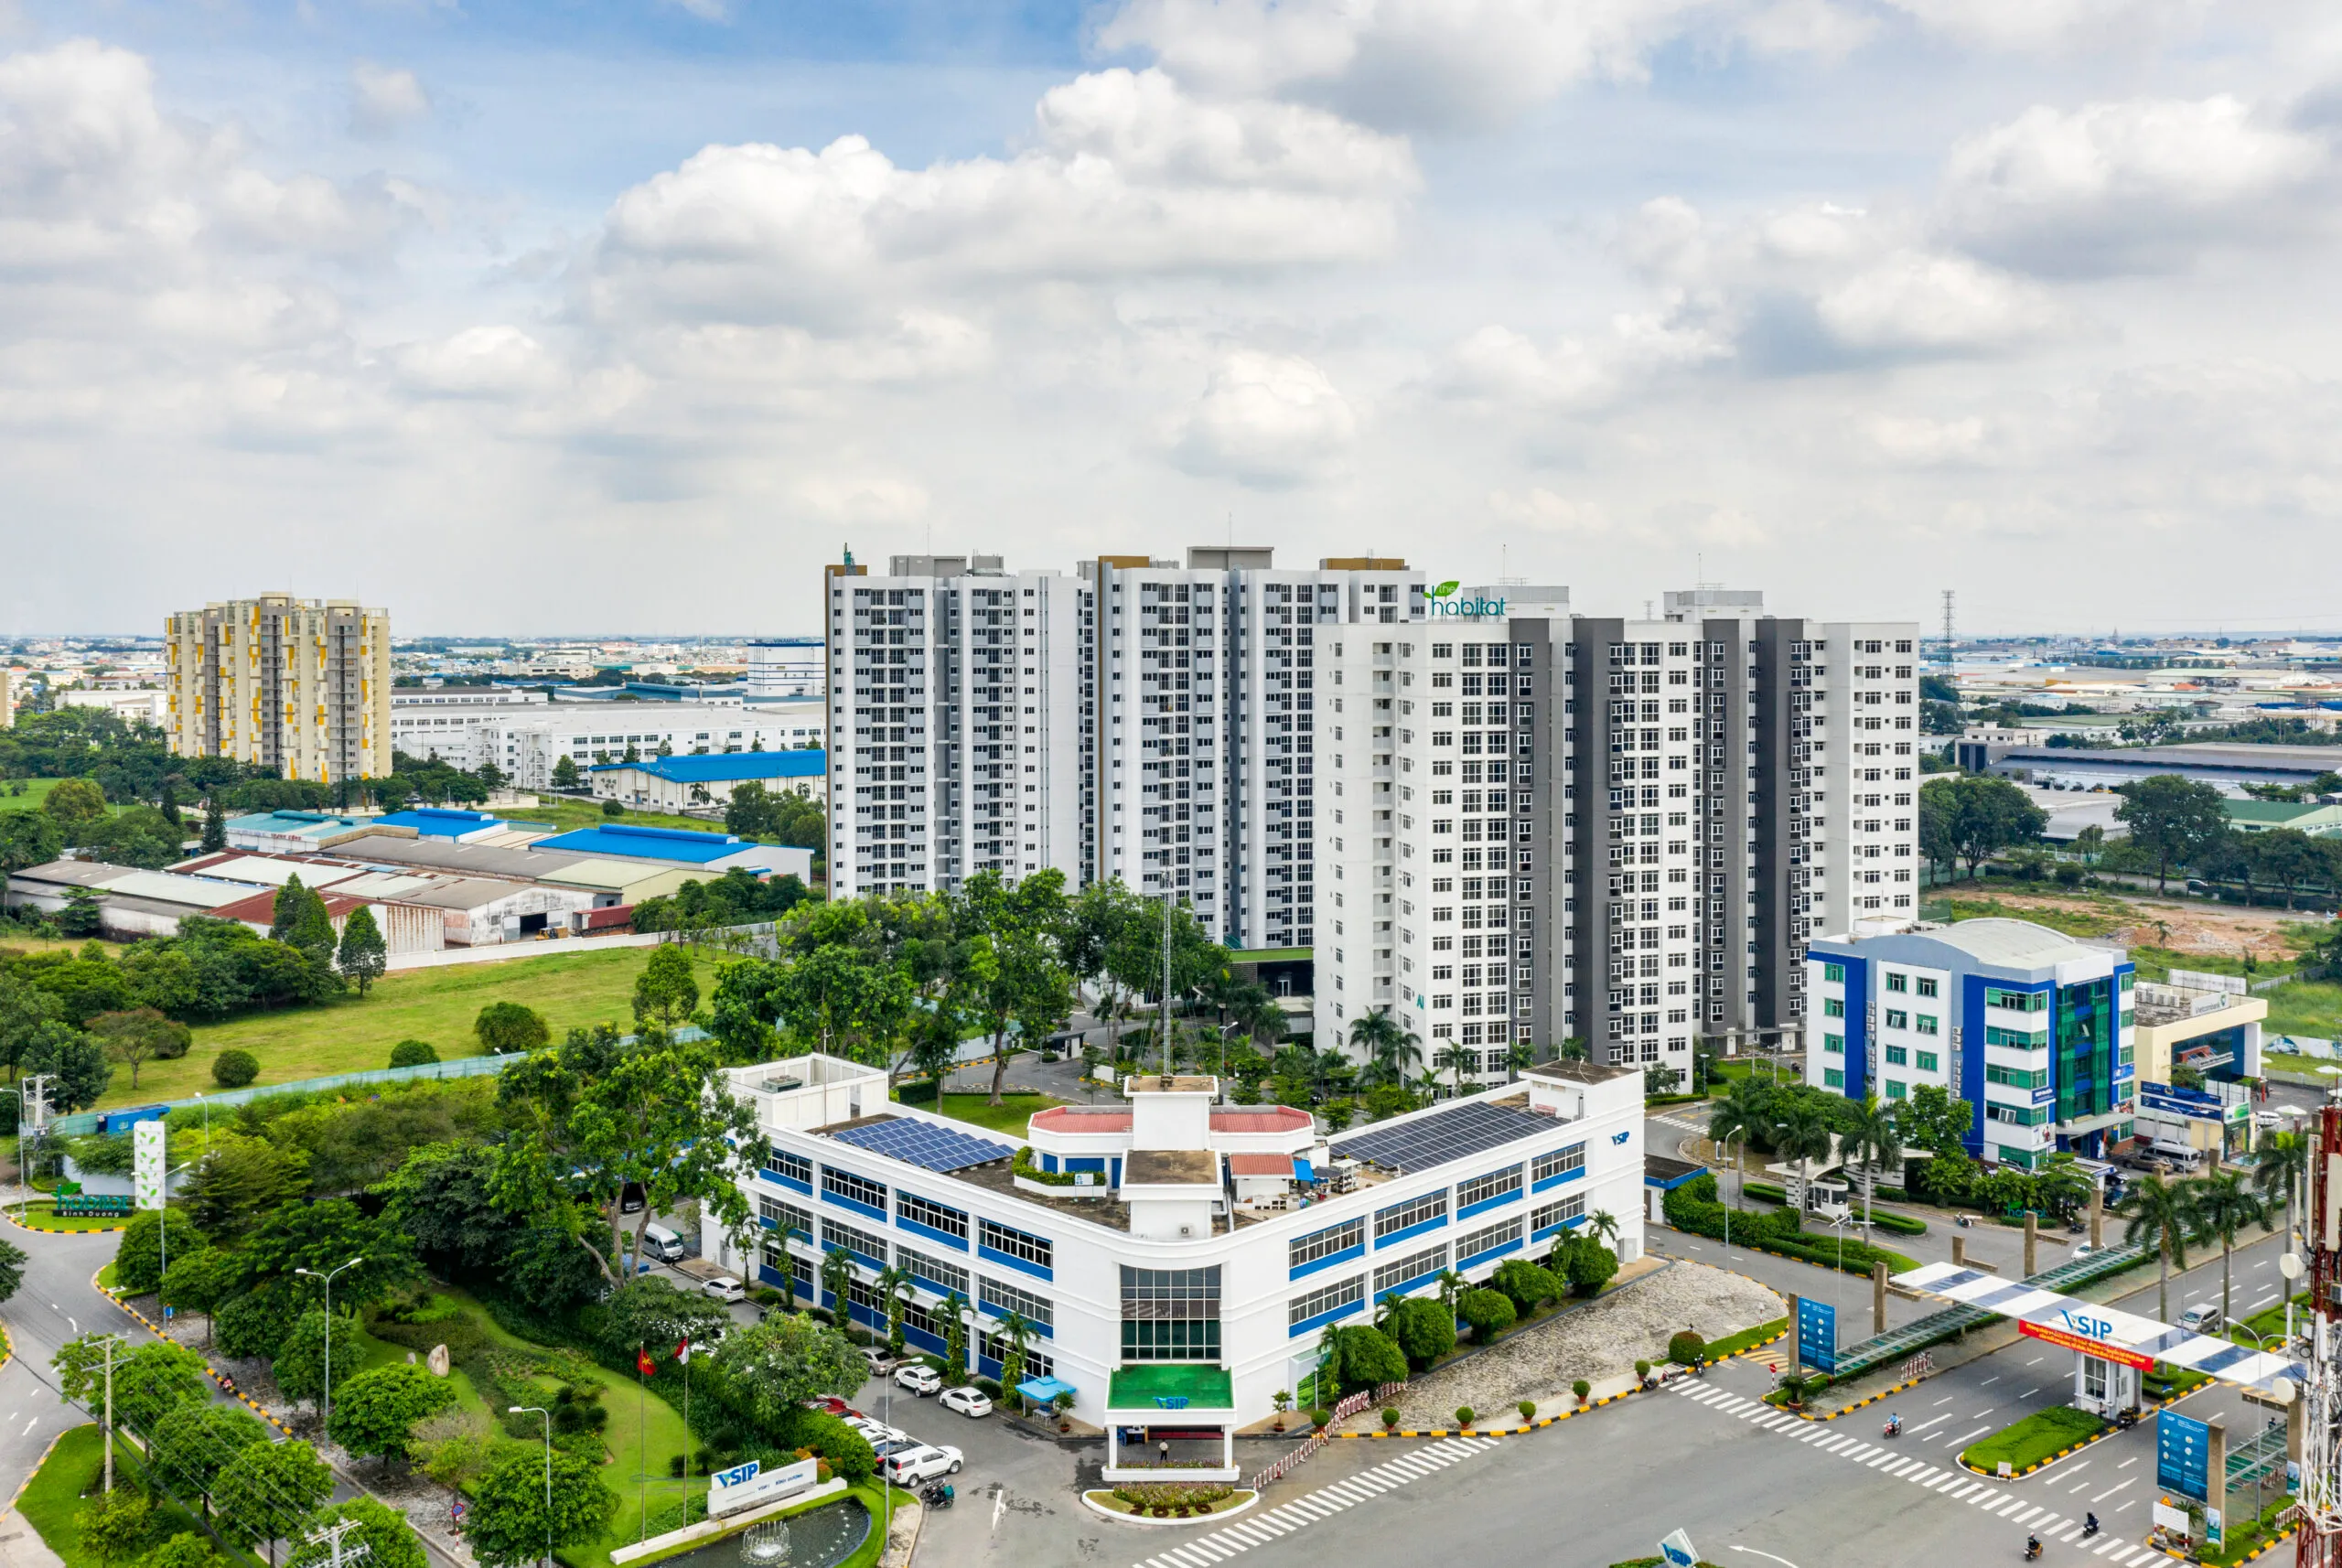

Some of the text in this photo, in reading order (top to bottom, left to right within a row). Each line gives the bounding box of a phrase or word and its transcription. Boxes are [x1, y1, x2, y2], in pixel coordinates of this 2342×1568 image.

[1431, 585, 1506, 616] habitat
[1439, 585, 1456, 594] the
[1611, 1131, 1629, 1145] VSIP
[57, 1185, 129, 1210] habitat
[2057, 1307, 2112, 1340] VSIP
[1153, 1396, 1189, 1410] VSIP
[714, 1463, 758, 1488] VSIP
[1660, 1542, 1692, 1567] VSIP
